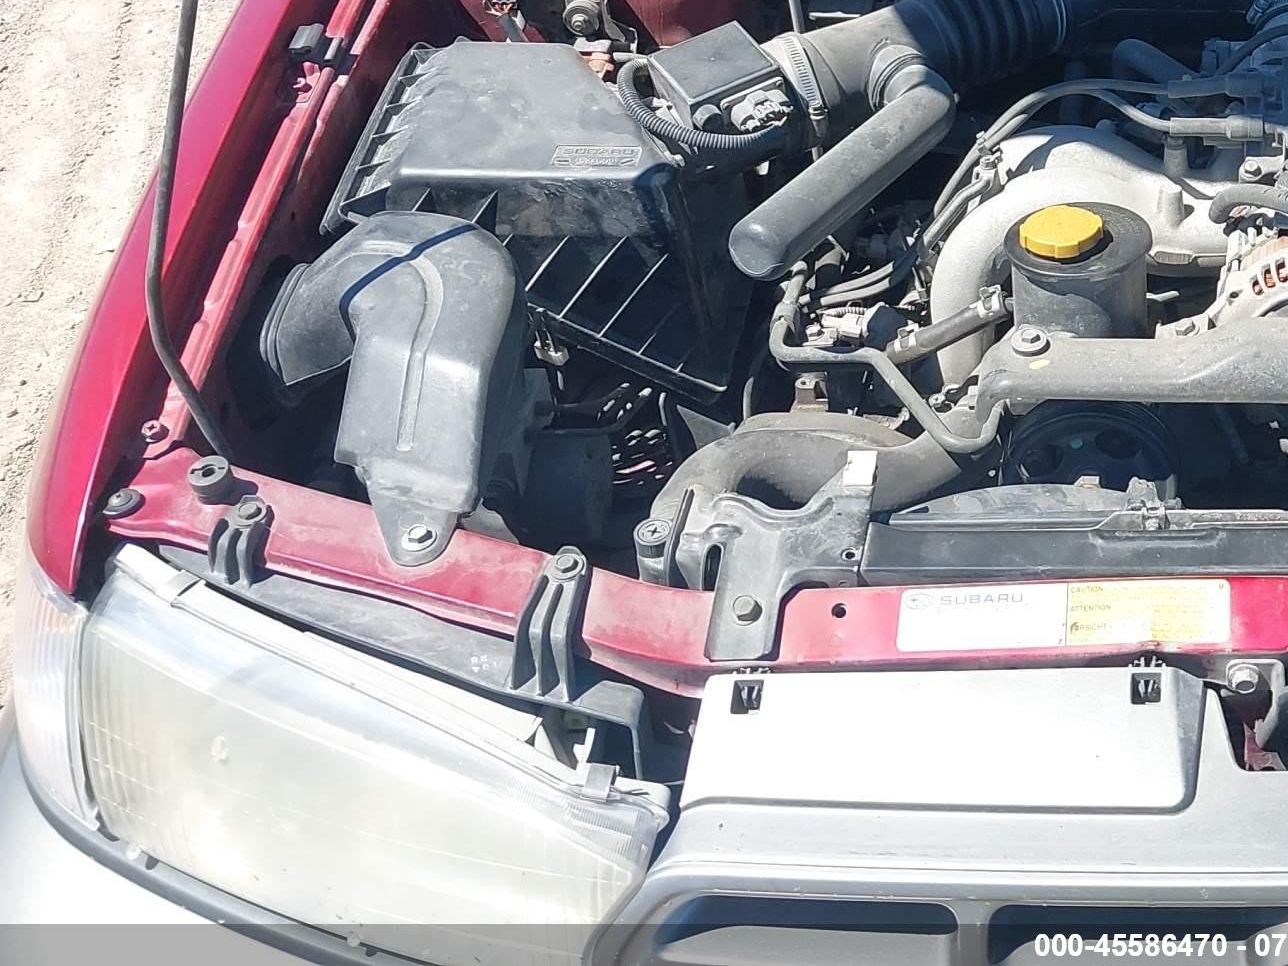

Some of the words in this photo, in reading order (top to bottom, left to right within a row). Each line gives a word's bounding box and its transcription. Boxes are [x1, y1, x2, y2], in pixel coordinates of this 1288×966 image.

[1071, 586, 1104, 594] CAUTION
[940, 593, 1024, 605] SUBARU
[1071, 604, 1112, 612] ATTENTION
